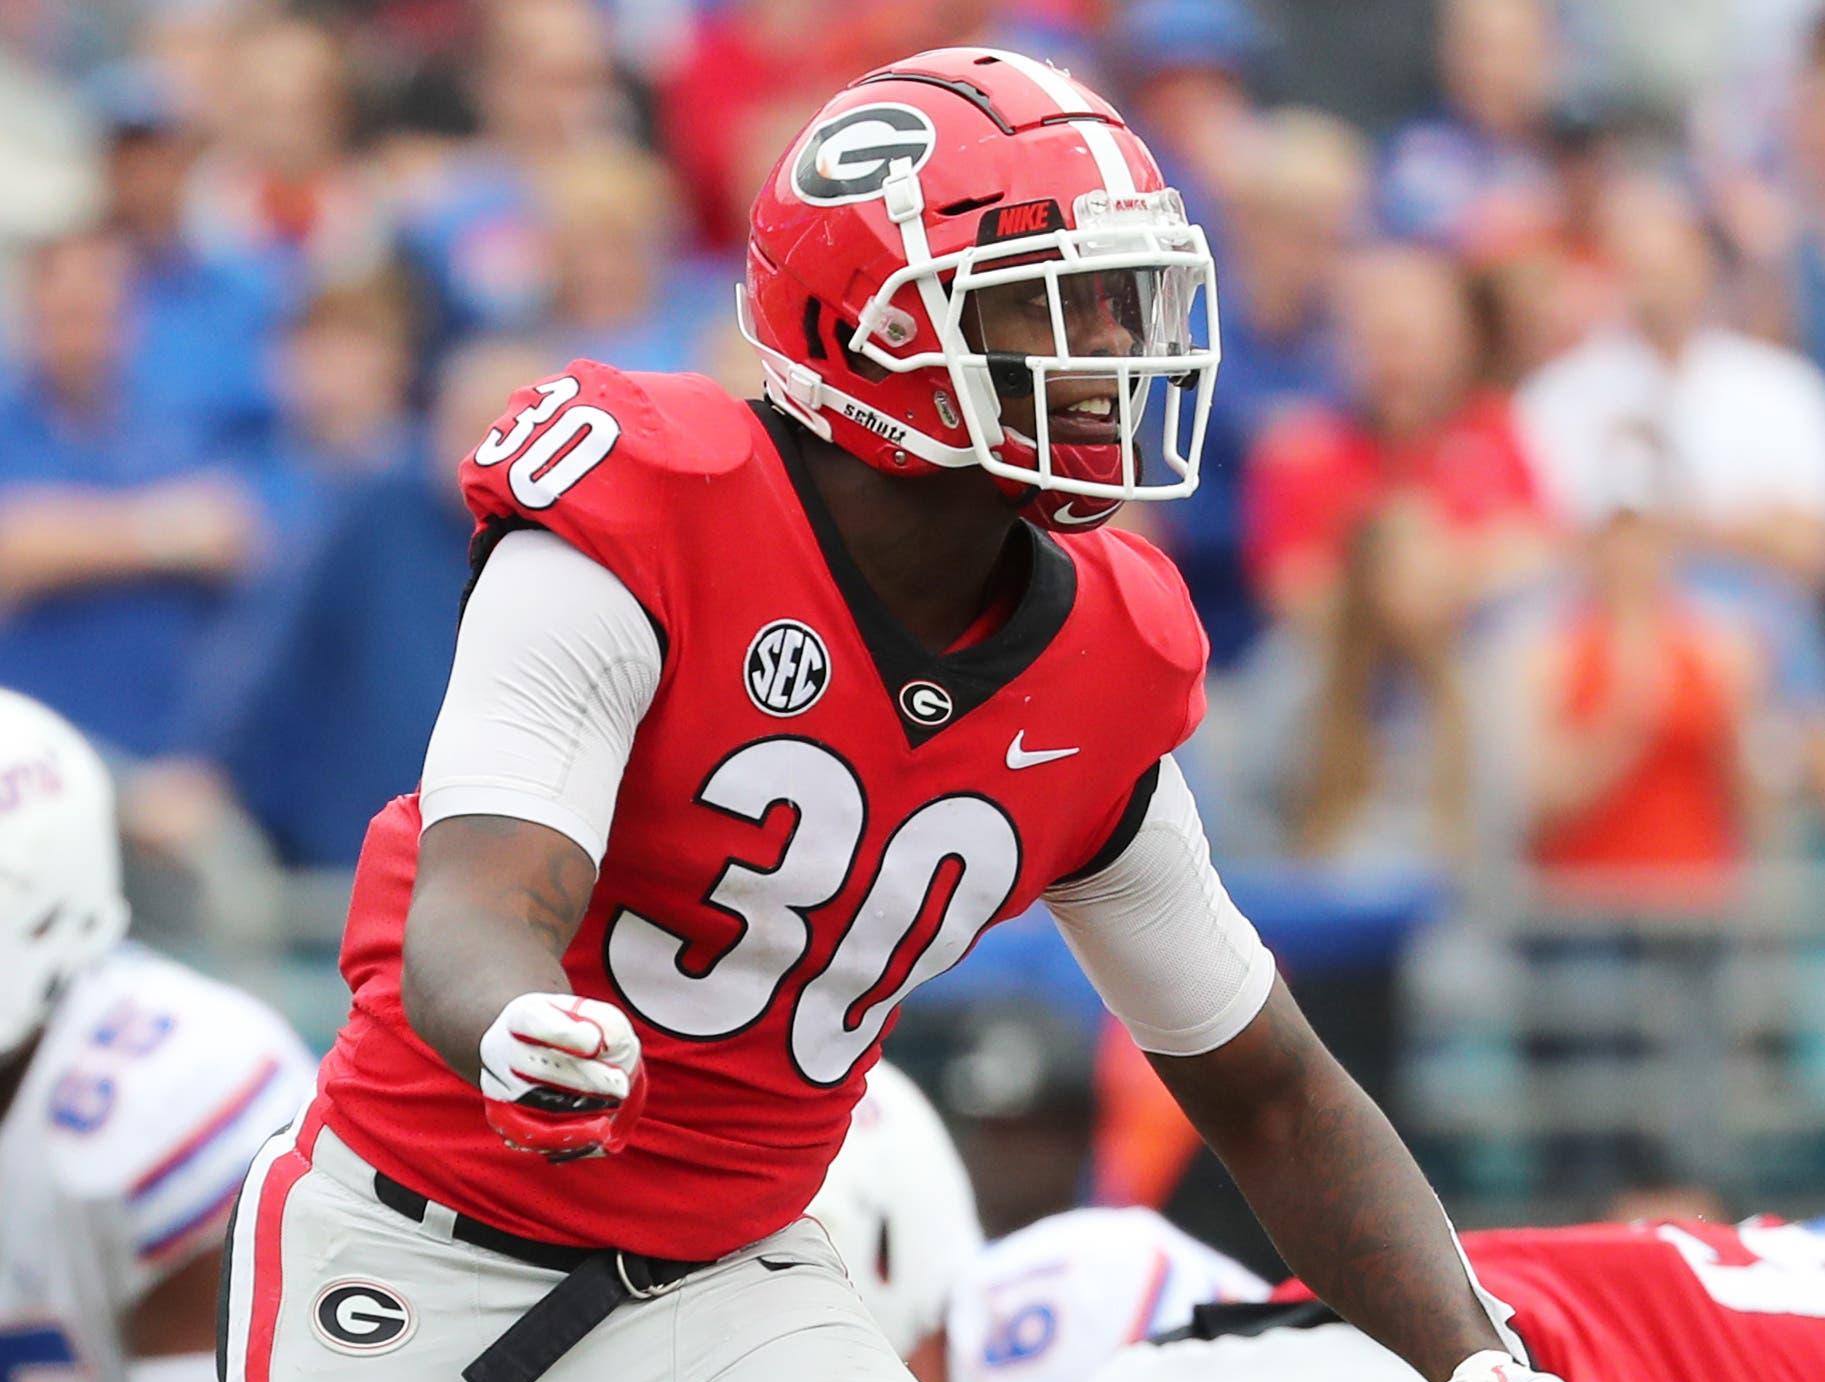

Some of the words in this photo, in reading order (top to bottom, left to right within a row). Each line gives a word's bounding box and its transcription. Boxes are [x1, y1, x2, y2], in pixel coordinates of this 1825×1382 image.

[796, 107, 929, 199] G
[997, 201, 1050, 237] NIKE
[474, 375, 622, 510] 30
[843, 403, 907, 442] schutt
[750, 627, 823, 710] SEC
[902, 683, 951, 723] G
[606, 734, 1023, 1088] 30
[318, 1285, 407, 1346] G
